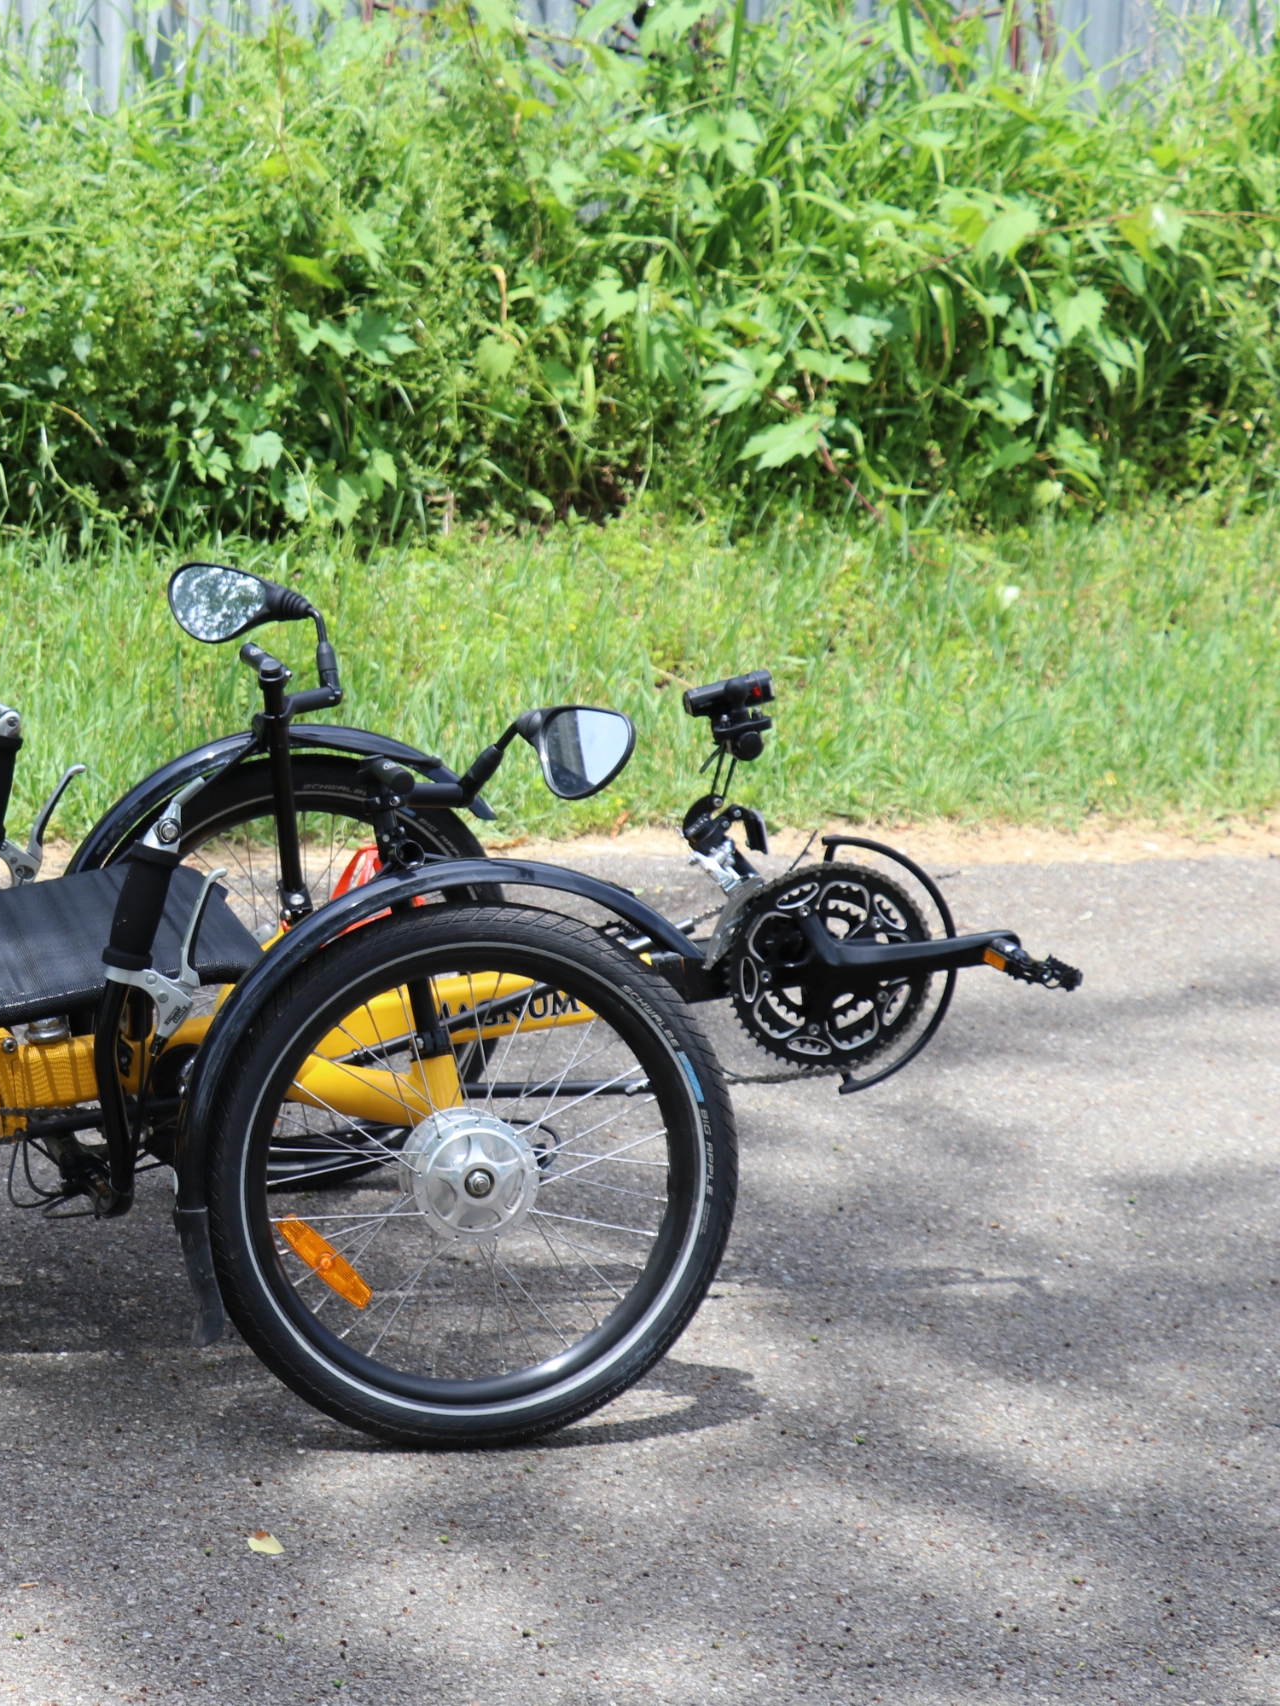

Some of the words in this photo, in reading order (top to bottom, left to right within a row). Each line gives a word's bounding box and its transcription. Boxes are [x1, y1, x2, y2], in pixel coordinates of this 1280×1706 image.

[438, 834, 463, 859] APP
[622, 984, 681, 1048] SCHWALBE
[700, 1108, 712, 1137] BIG
[705, 1141, 715, 1197] APPLE
